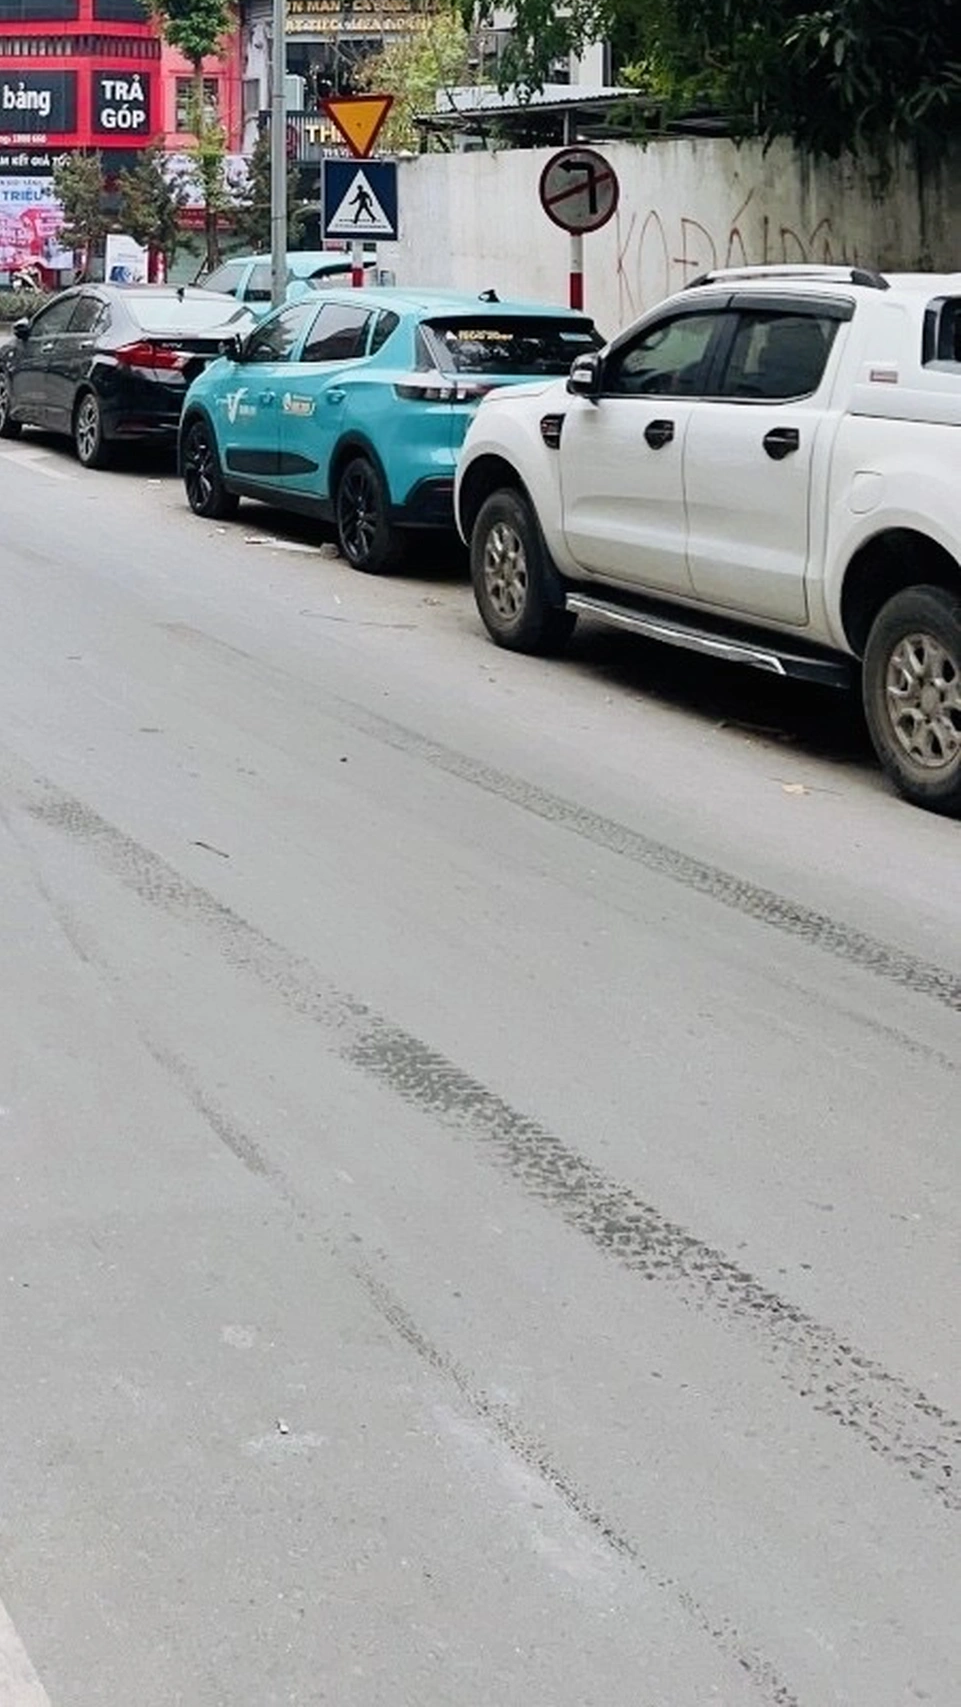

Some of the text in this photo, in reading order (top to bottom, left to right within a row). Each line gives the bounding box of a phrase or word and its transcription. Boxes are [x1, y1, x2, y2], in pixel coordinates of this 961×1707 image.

[2, 81, 52, 116] bảng
[101, 74, 145, 101] TRẢ
[101, 103, 146, 129] GÓP
